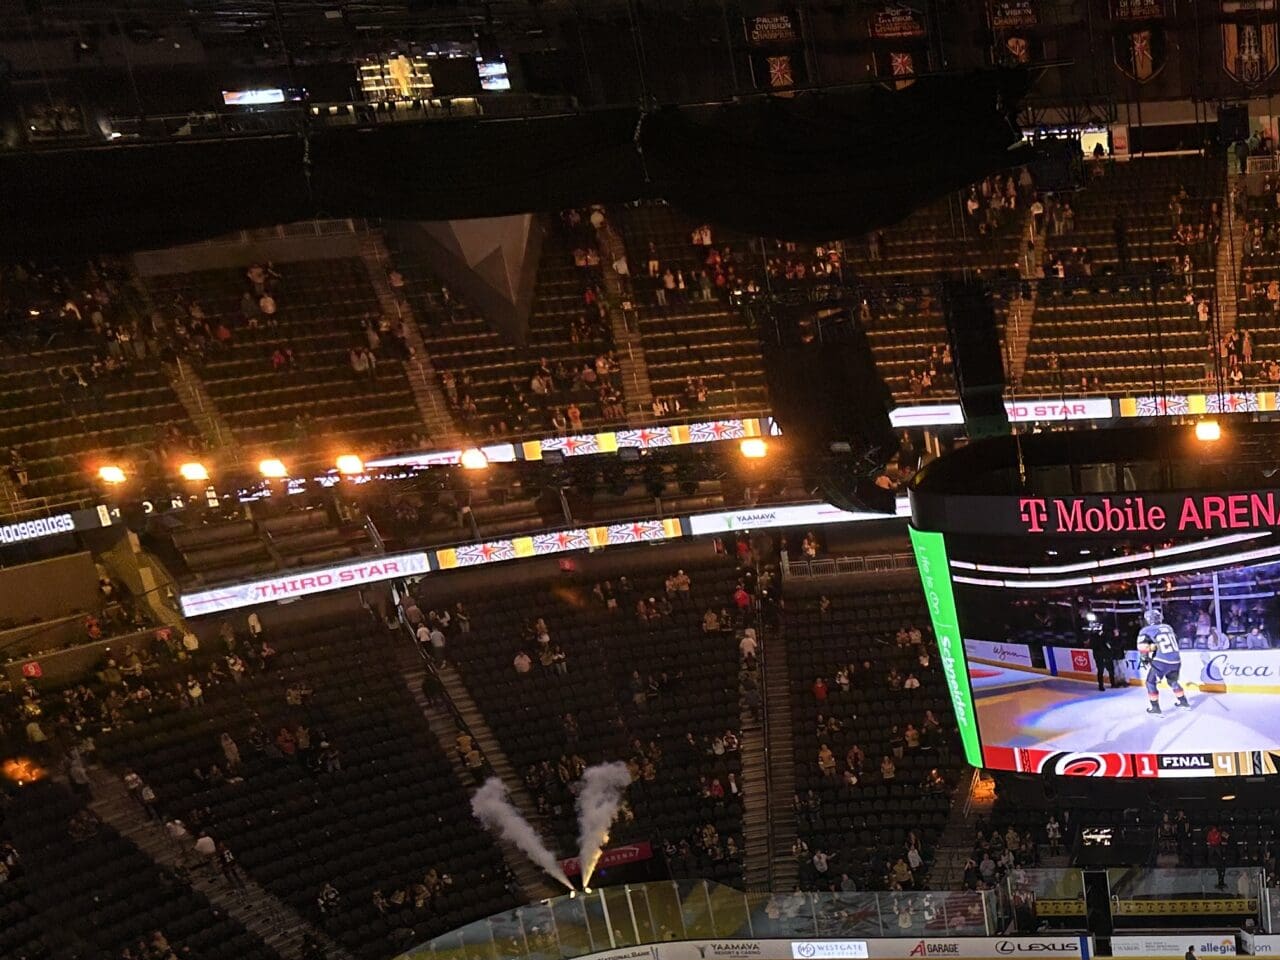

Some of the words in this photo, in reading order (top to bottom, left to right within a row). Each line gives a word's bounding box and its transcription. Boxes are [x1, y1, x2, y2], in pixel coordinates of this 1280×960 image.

[1034, 404, 1087, 417] STAR
[255, 573, 332, 596] THIRD
[339, 560, 400, 583] STAR
[1053, 597, 1166, 633] Mobile
[1204, 653, 1274, 682] Circa
[940, 635, 969, 729] Schneider
[1162, 755, 1210, 768] FINAL
[1217, 754, 1232, 774] 4
[816, 943, 863, 951] WESTGATE
[927, 943, 959, 953] GARAGE
[1018, 942, 1079, 951] LEXUS
